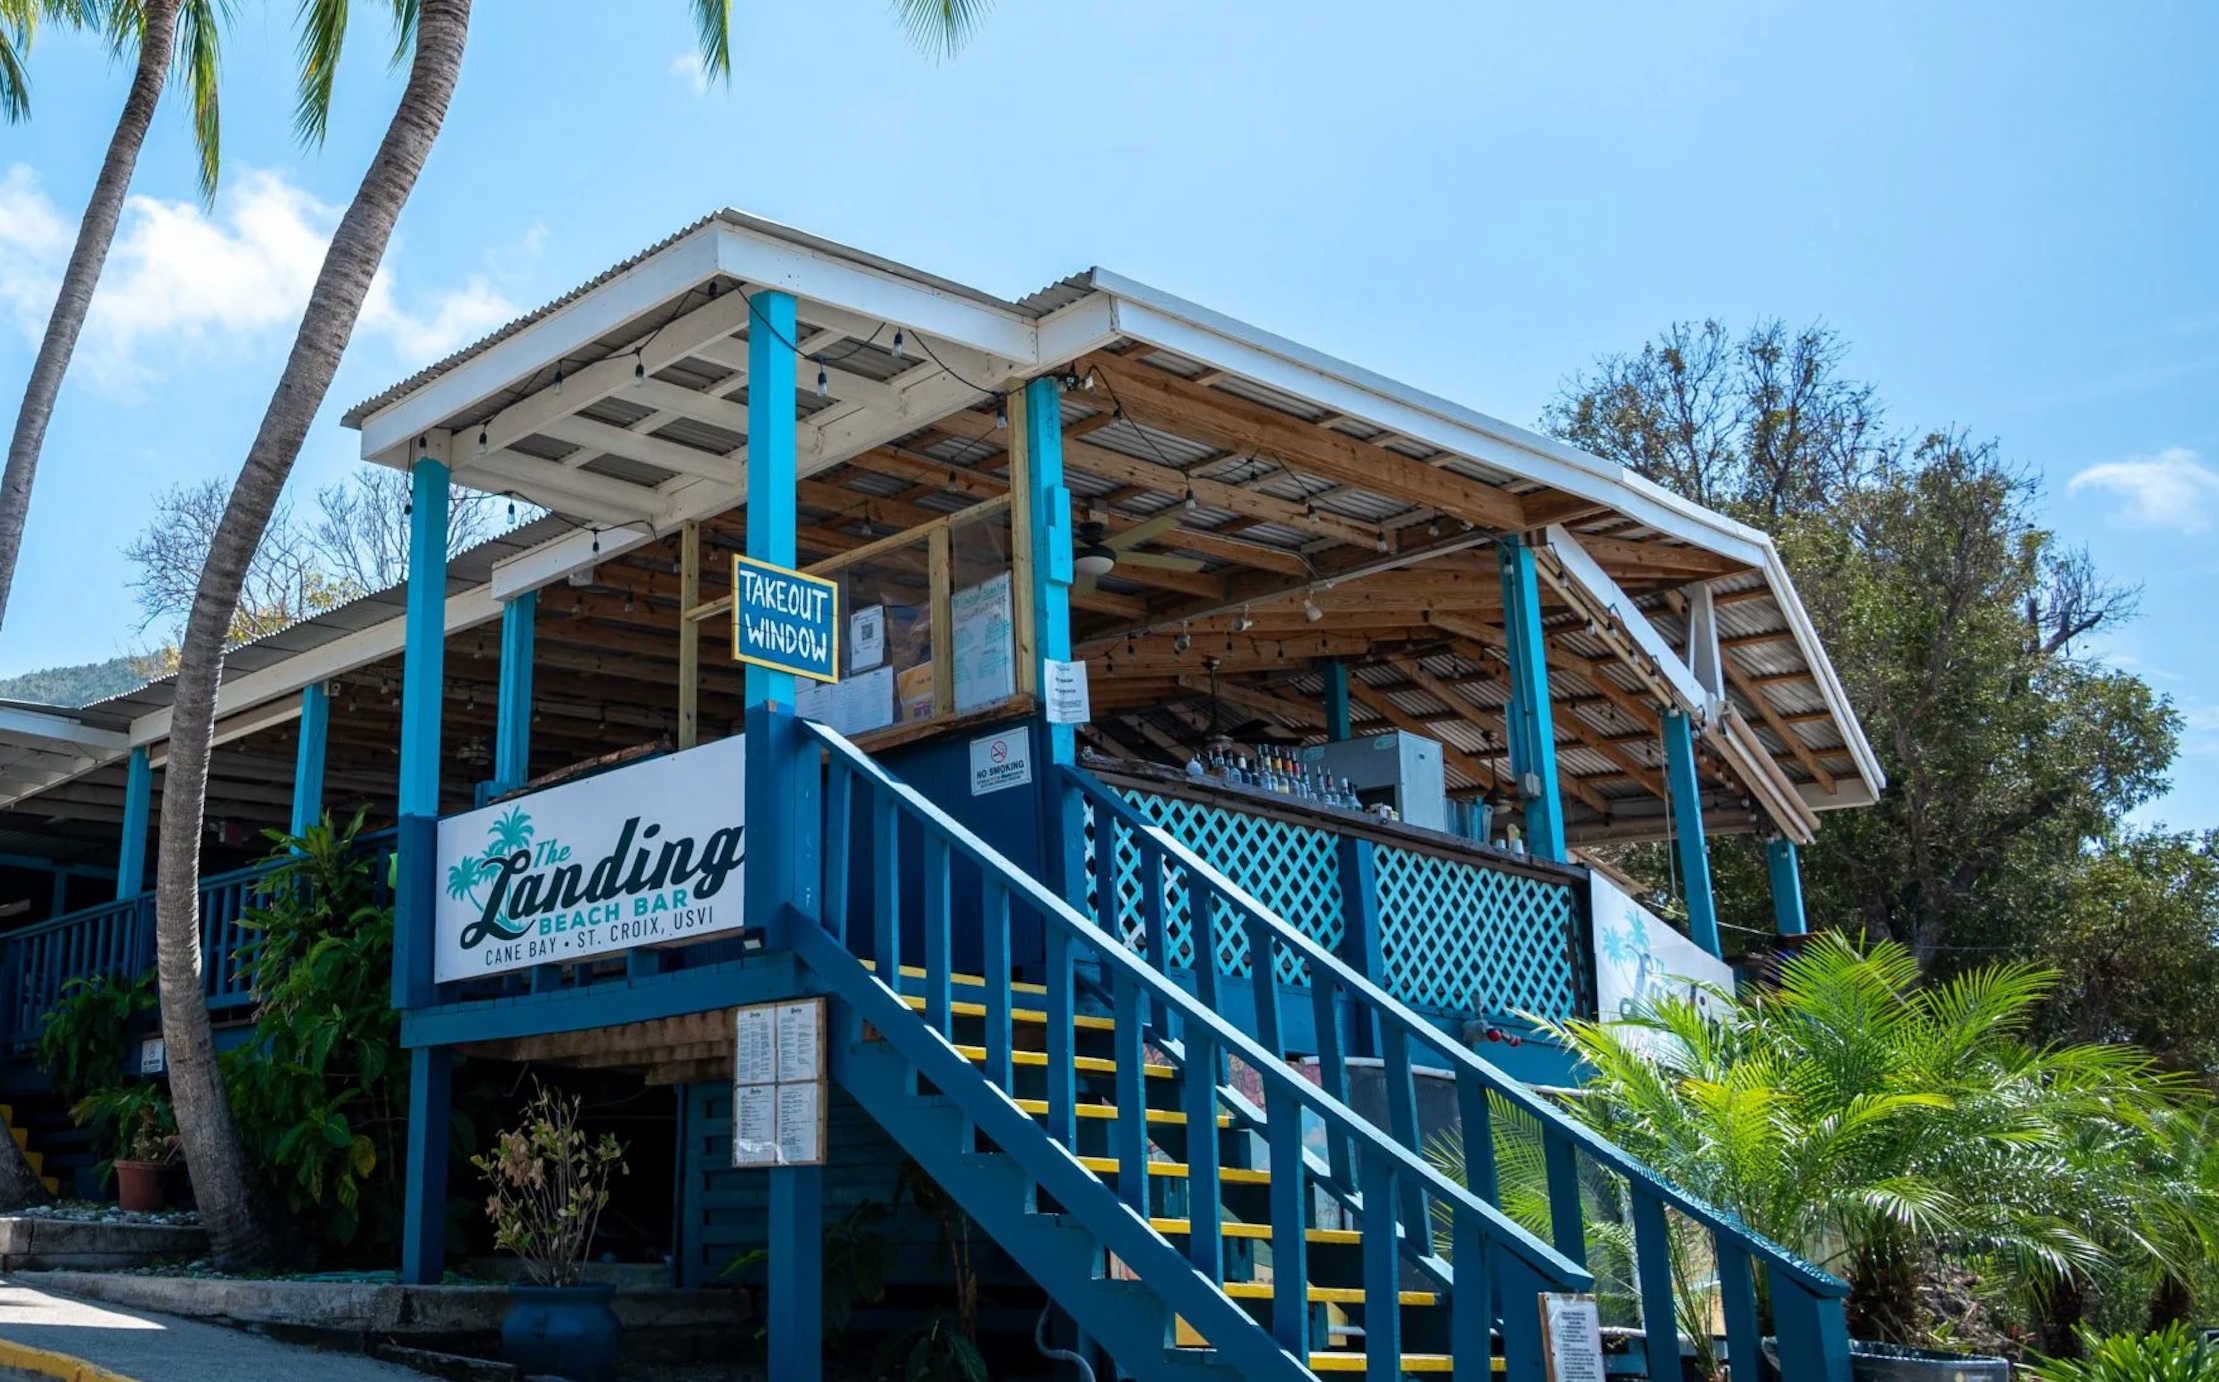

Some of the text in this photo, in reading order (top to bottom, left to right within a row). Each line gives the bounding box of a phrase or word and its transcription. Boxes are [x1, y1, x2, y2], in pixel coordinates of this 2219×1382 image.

[740, 570, 828, 624] TAKEOUT
[745, 613, 826, 664] WINDOW
[976, 769, 987, 779] NO
[989, 760, 1024, 776] SMOKING
[533, 838, 571, 869] The
[460, 816, 745, 950] Landing
[485, 905, 713, 966] CANE BAY ST. CROIX, USVI
[538, 889, 688, 936] BEACH BAR
